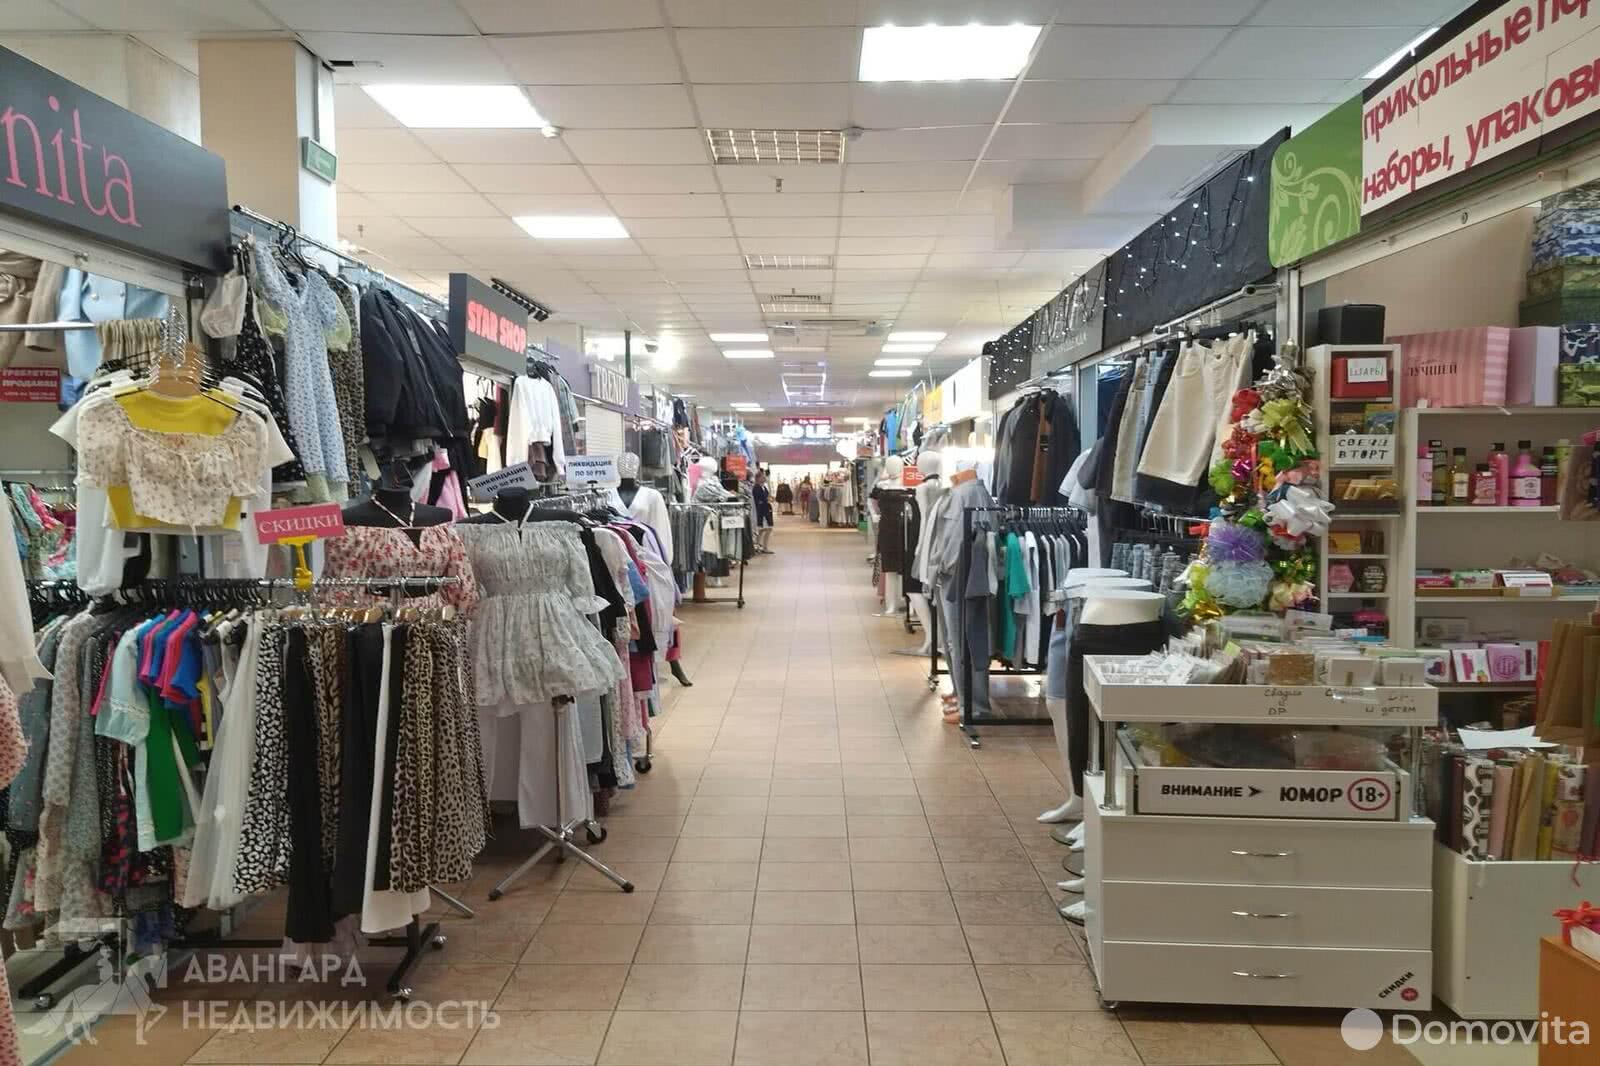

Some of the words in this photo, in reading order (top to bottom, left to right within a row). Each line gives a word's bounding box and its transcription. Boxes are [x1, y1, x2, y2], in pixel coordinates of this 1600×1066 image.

[1364, 6, 1533, 143] прикольные
[1364, 135, 1455, 203] наборы,
[468, 300, 498, 343] STAR
[499, 316, 527, 354] SHOP
[474, 466, 528, 488] ЛИКВИДАЦИЯ
[486, 484, 498, 492] ПО
[259, 514, 340, 534] СКИДКИ
[1160, 784, 1244, 798] ВНИМАНИЕ
[1279, 786, 1343, 802] ЮМОР
[1355, 786, 1386, 803] 18+
